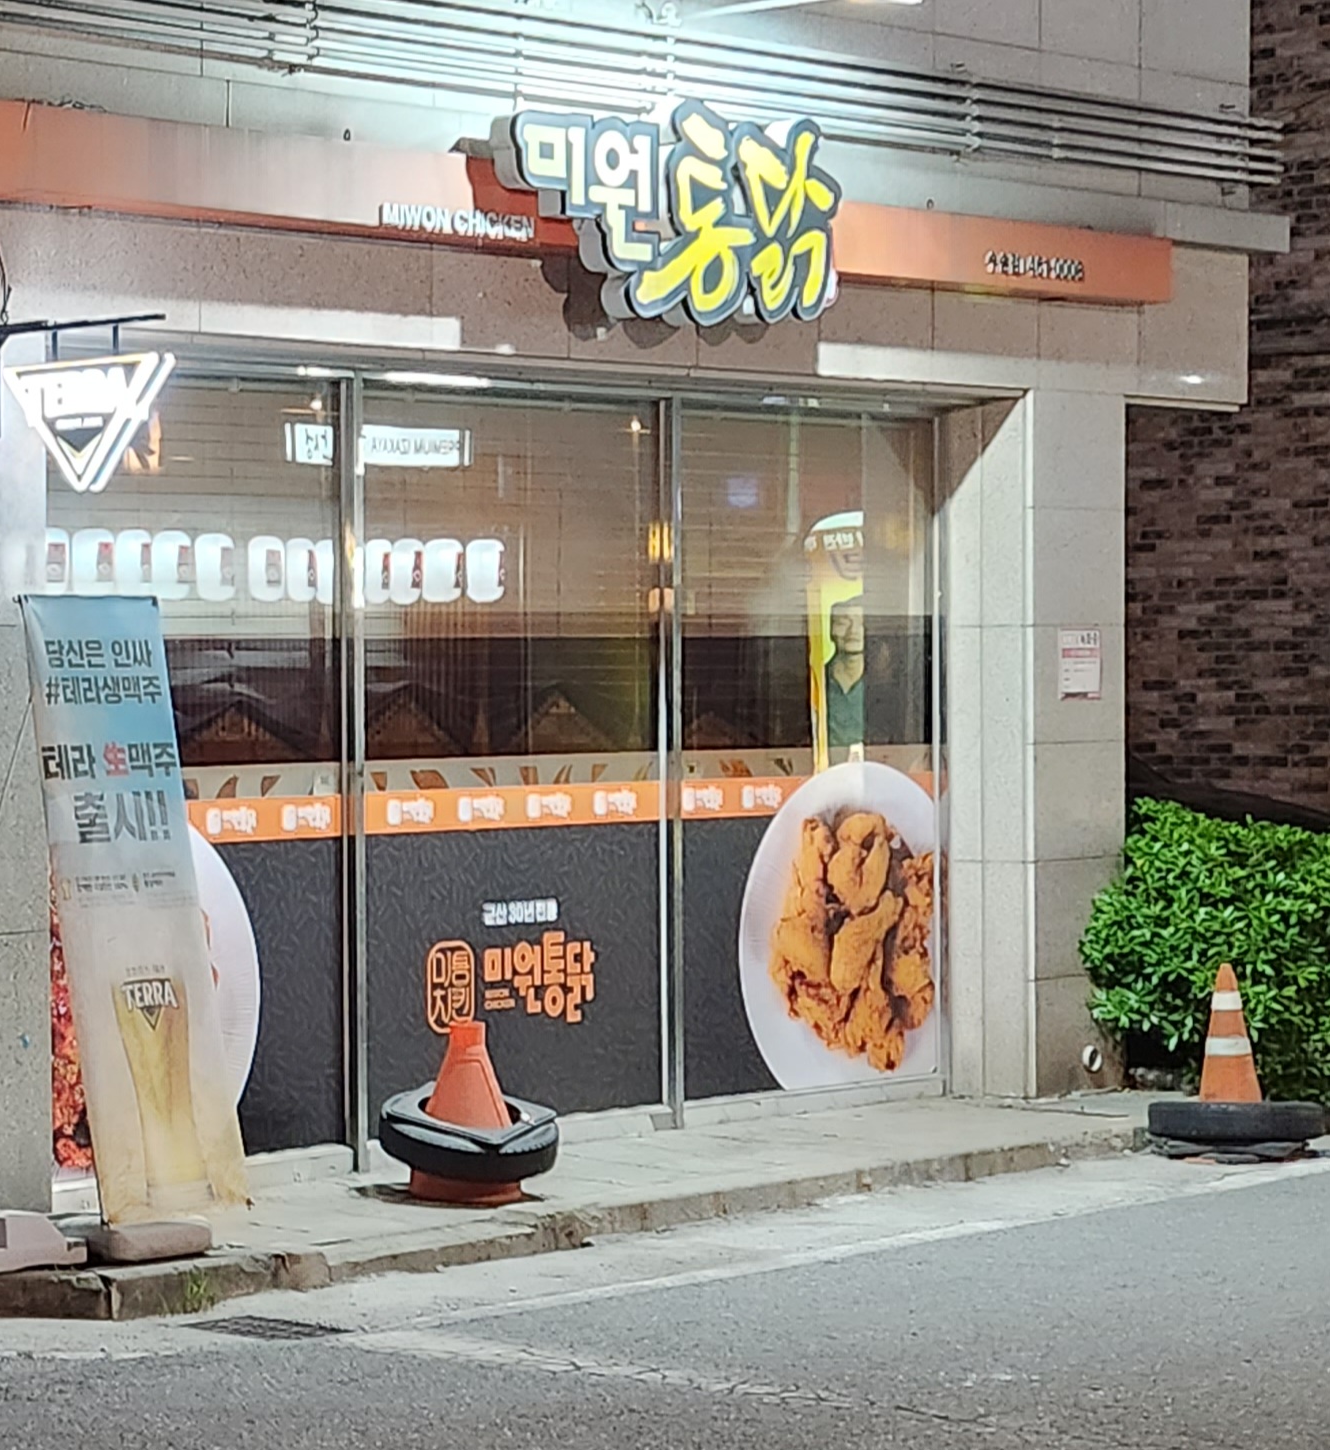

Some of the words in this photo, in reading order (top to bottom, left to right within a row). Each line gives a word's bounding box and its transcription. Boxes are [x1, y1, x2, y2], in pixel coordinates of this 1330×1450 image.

[378, 202, 448, 235] MIWON
[451, 209, 535, 243] CHICKEN
[522, 127, 653, 262] 미원
[636, 110, 836, 313] 통닭
[44, 639, 106, 669] 당신은
[111, 639, 152, 669] 인싸
[45, 676, 162, 705] #테라생맥주
[41, 743, 96, 780] 테라
[74, 789, 171, 843] 출시!!
[121, 980, 178, 1011] TERRA
[484, 931, 596, 1023] 미원통닭
